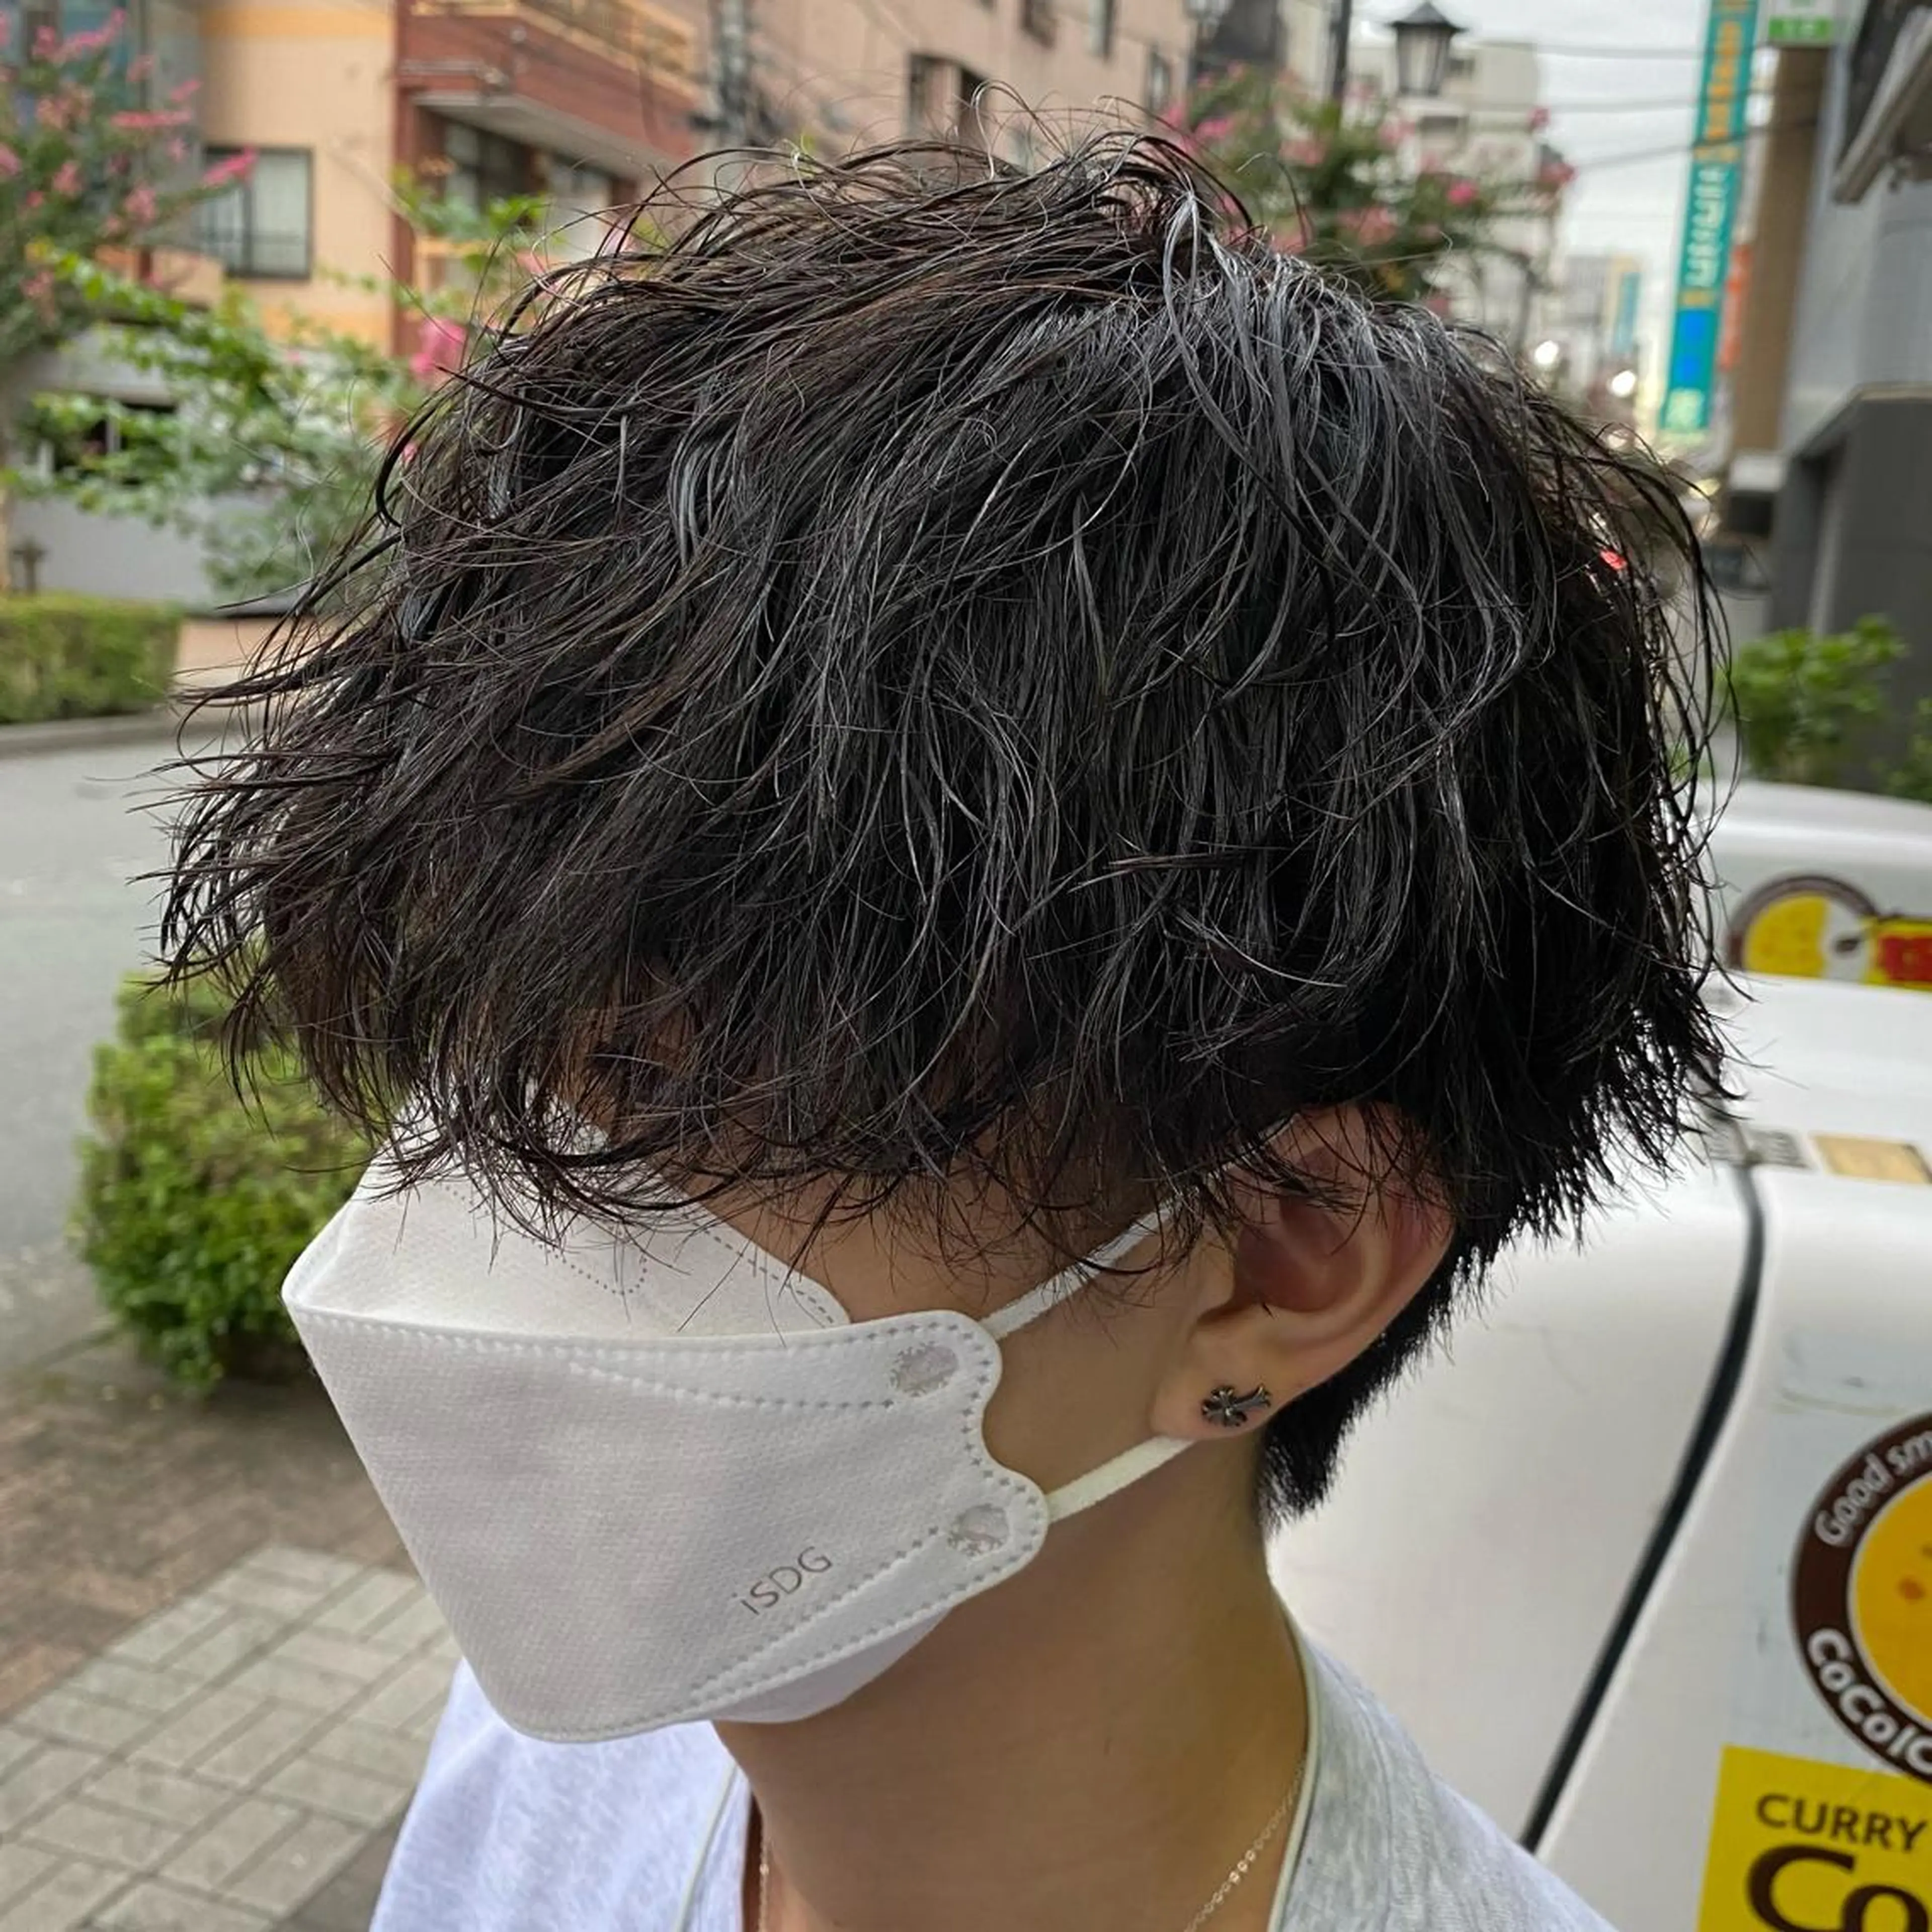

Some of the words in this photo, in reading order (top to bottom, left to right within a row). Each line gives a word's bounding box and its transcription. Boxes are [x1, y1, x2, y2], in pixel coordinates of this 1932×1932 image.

[1815, 1453, 1894, 1546] Good
[1886, 1430, 1932, 1476] sm
[731, 1546, 833, 1616] iSDG
[1755, 1793, 1928, 1853] CURRY
[1746, 1843, 1929, 1932] Co
